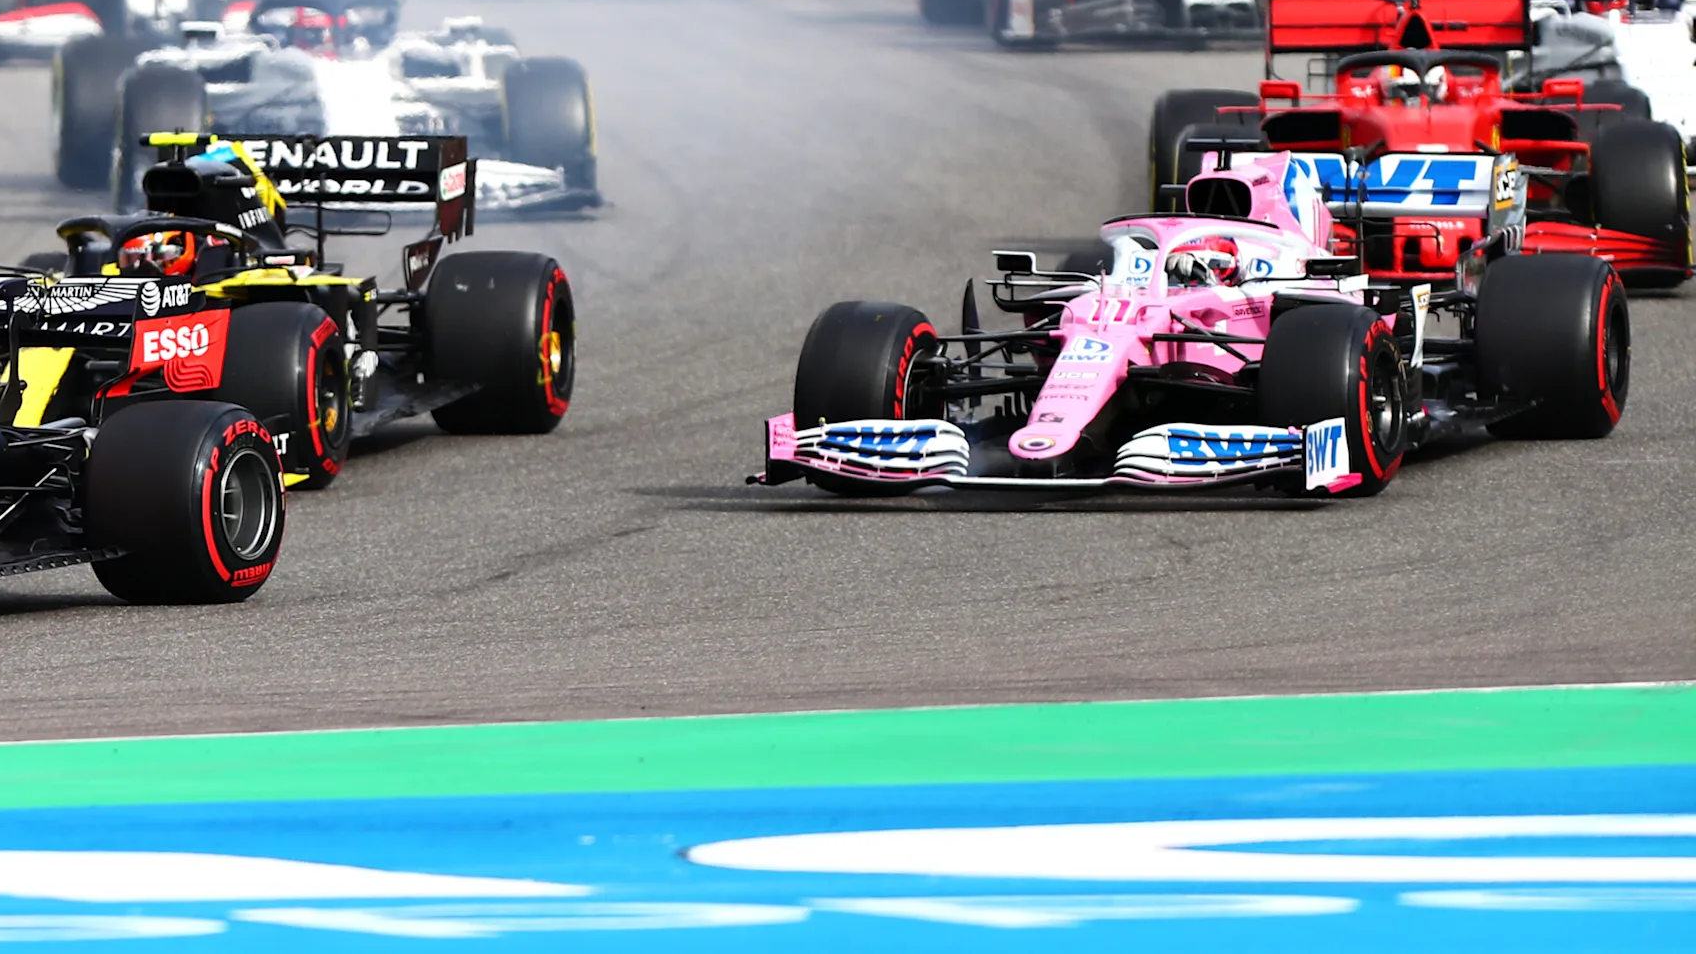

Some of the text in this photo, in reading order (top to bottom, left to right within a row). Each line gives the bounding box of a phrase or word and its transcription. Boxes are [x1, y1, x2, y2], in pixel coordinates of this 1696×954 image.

[51, 285, 93, 298] MARTIN
[162, 283, 192, 309] AT&T
[1091, 298, 1134, 325] 11
[142, 323, 210, 363] ESSO
[1306, 425, 1343, 476] BWT
